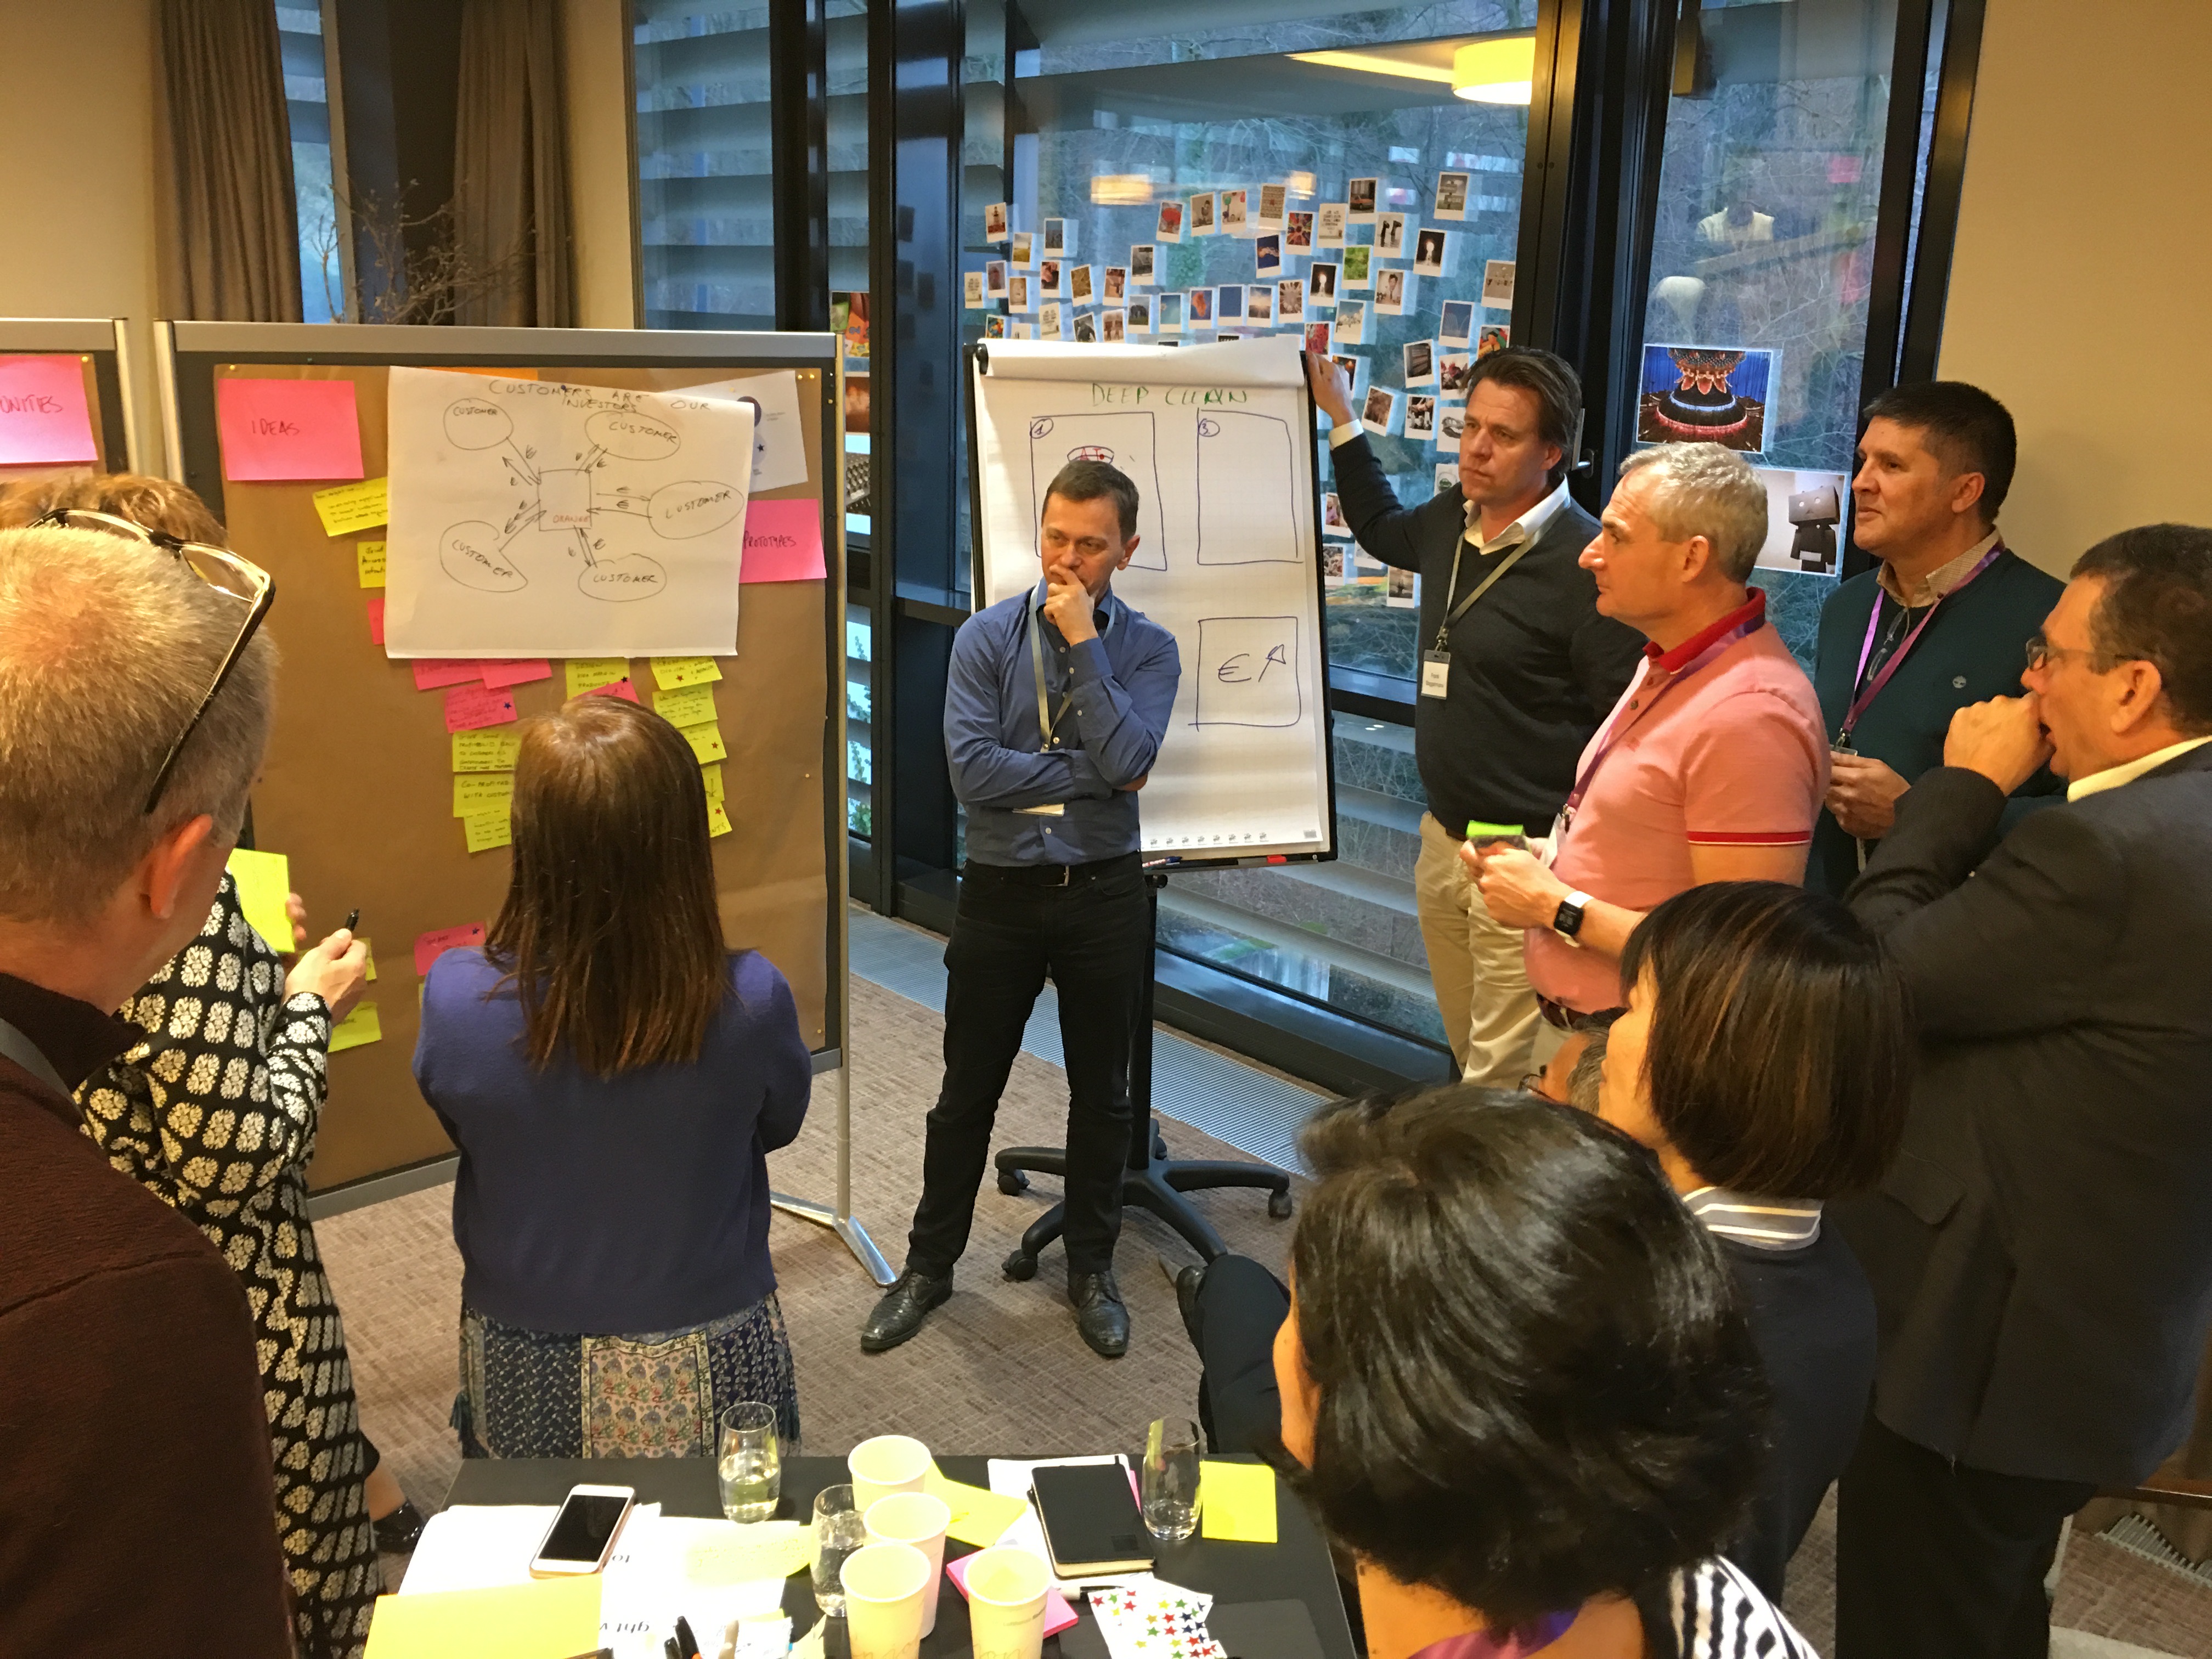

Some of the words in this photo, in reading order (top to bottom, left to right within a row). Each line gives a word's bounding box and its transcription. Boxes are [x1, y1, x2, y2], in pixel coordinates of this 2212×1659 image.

[489, 381, 592, 399] CUSTOMERS
[612, 391, 649, 403] ARE
[1092, 383, 1149, 407] DEEP
[453, 407, 498, 416] CUSTOMER
[562, 393, 637, 413] INVESTORS
[670, 399, 711, 410] OUR
[252, 419, 300, 436] IDEAS
[609, 421, 678, 445] CUSTOMER
[665, 490, 732, 519] CUSTOMER
[743, 530, 797, 549] PROTOTYPES
[593, 574, 658, 583] CUSTOMER
